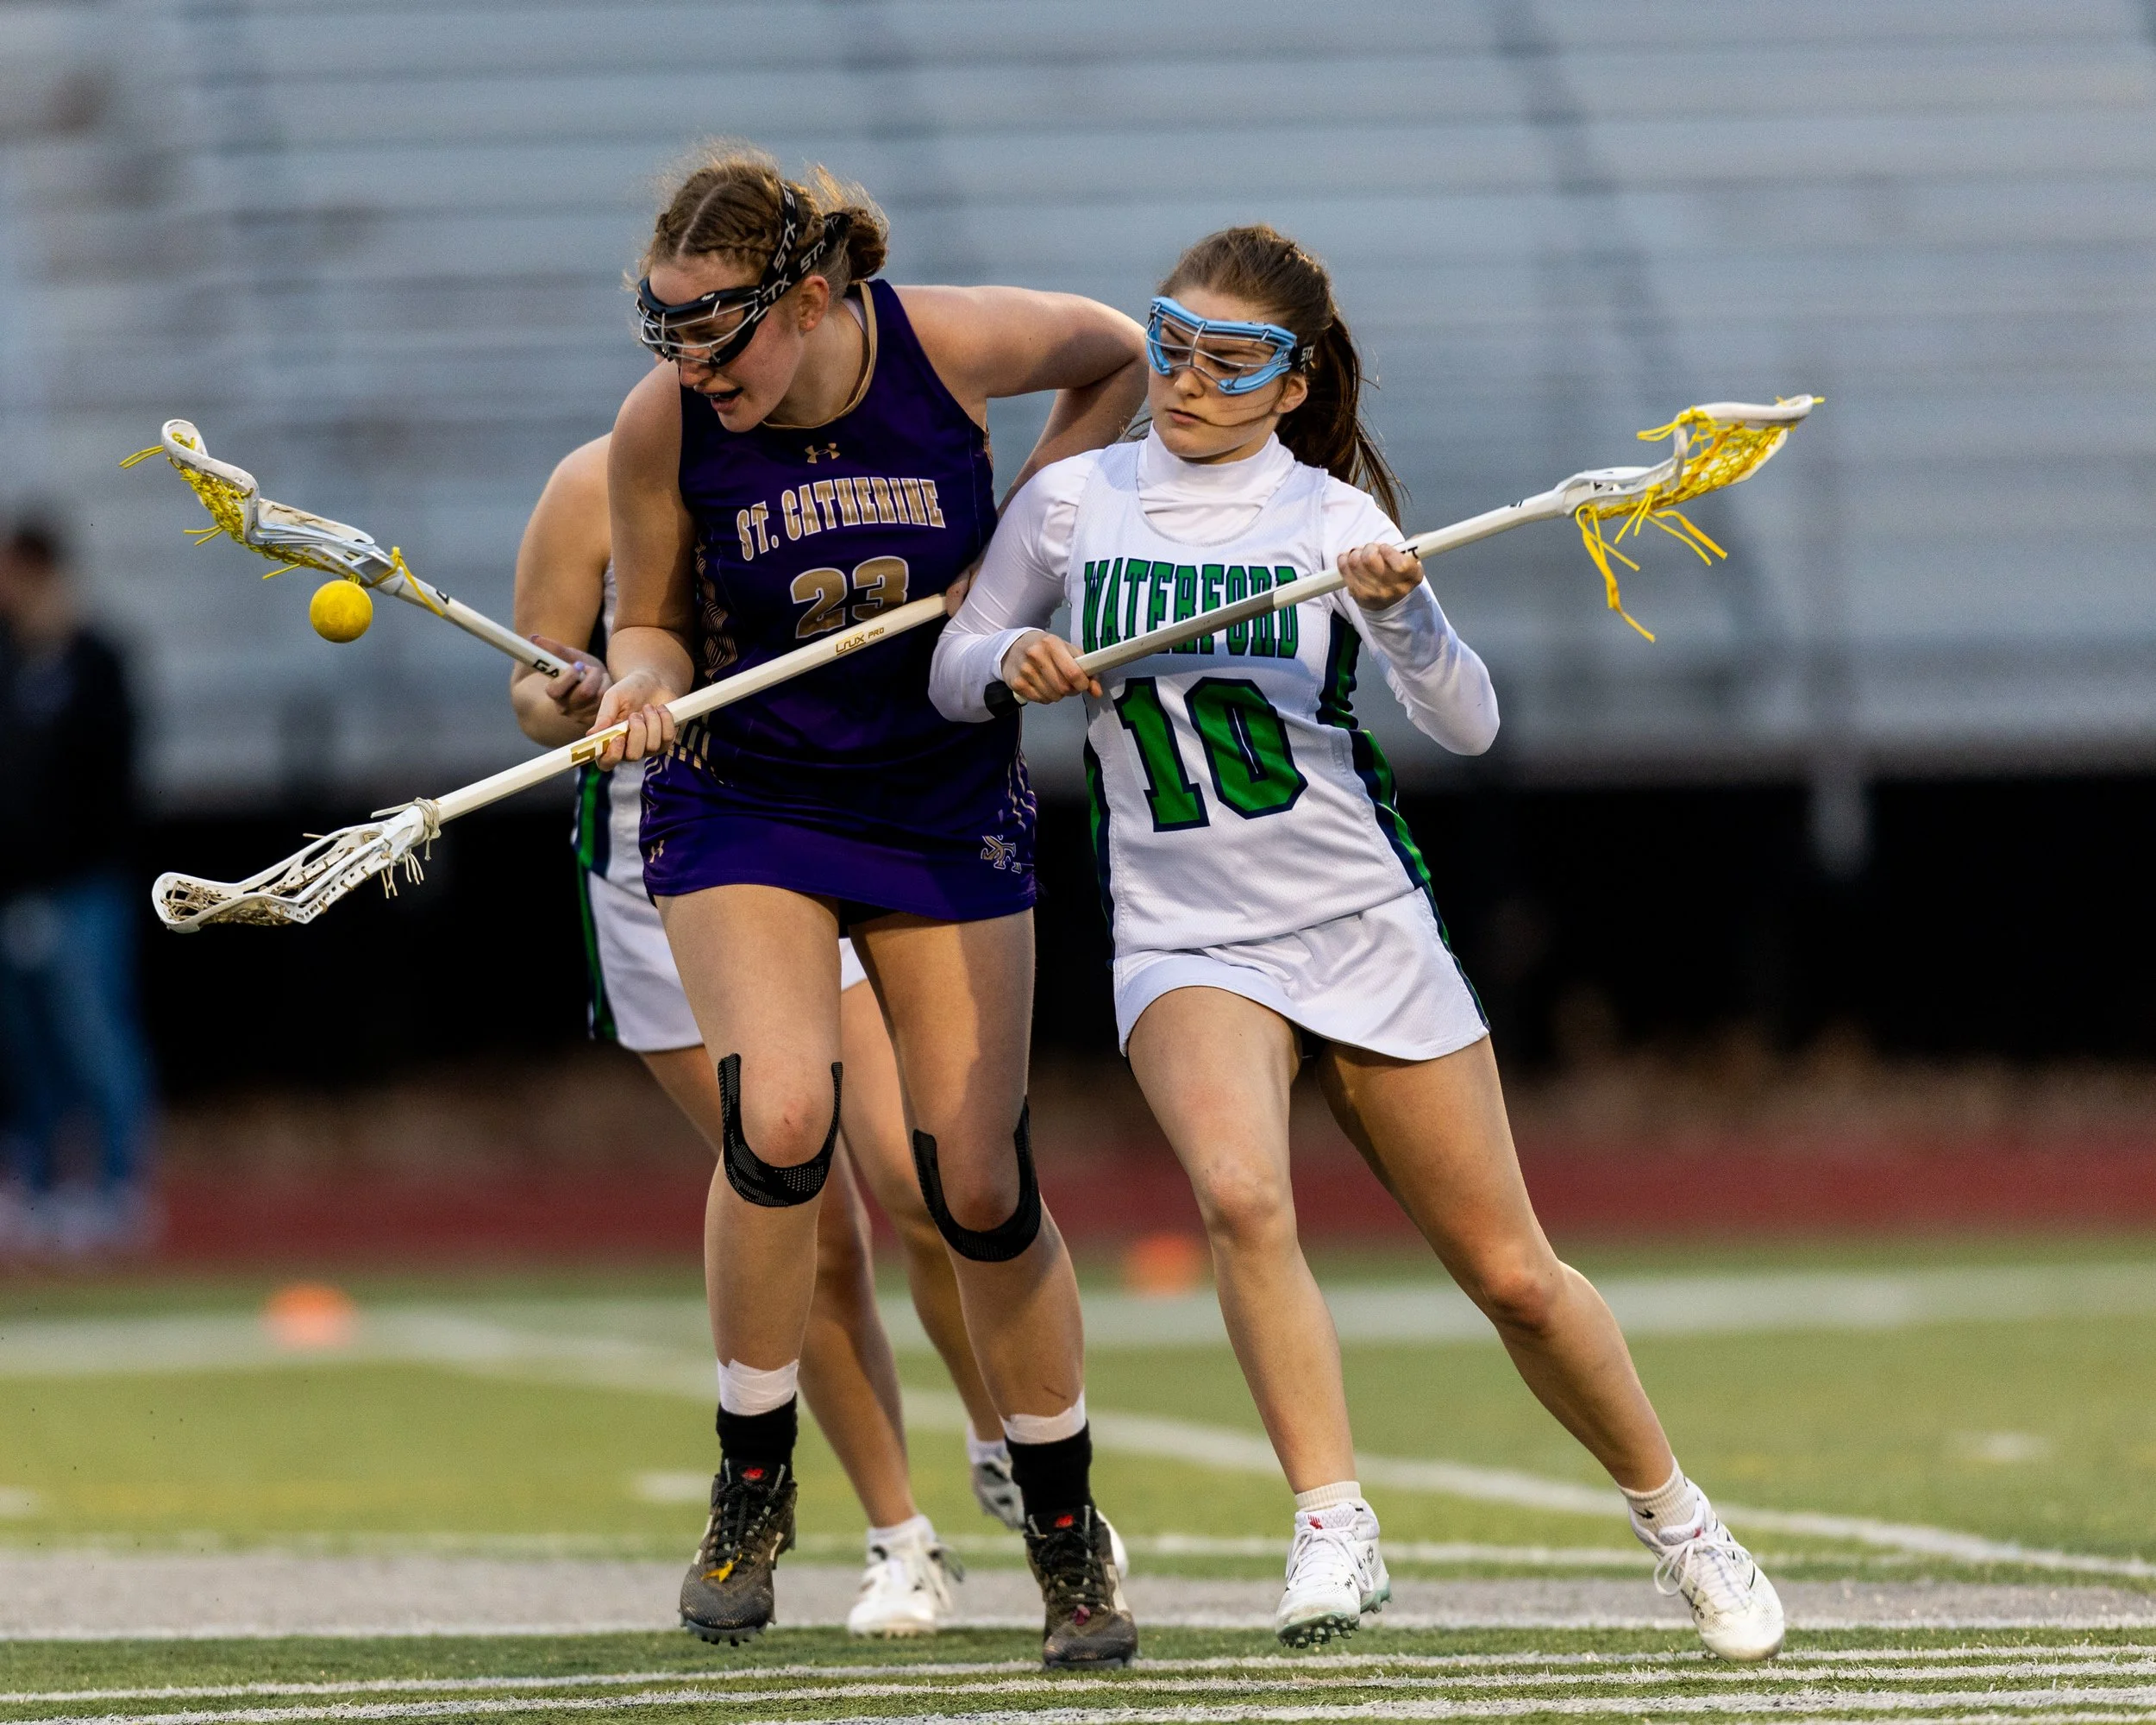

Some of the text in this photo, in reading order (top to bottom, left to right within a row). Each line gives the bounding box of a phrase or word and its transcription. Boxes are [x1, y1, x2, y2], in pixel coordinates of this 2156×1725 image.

[773, 218, 797, 274] STX
[799, 238, 827, 274] STX
[1300, 344, 1315, 362] STX
[736, 476, 946, 561] ST. CATHERINE
[789, 555, 910, 639] 23
[1081, 556, 1299, 660] WATERFORD
[868, 627, 885, 639] PRO
[532, 658, 560, 679] GA
[570, 729, 630, 766] ST
[1112, 675, 1309, 833] 10
